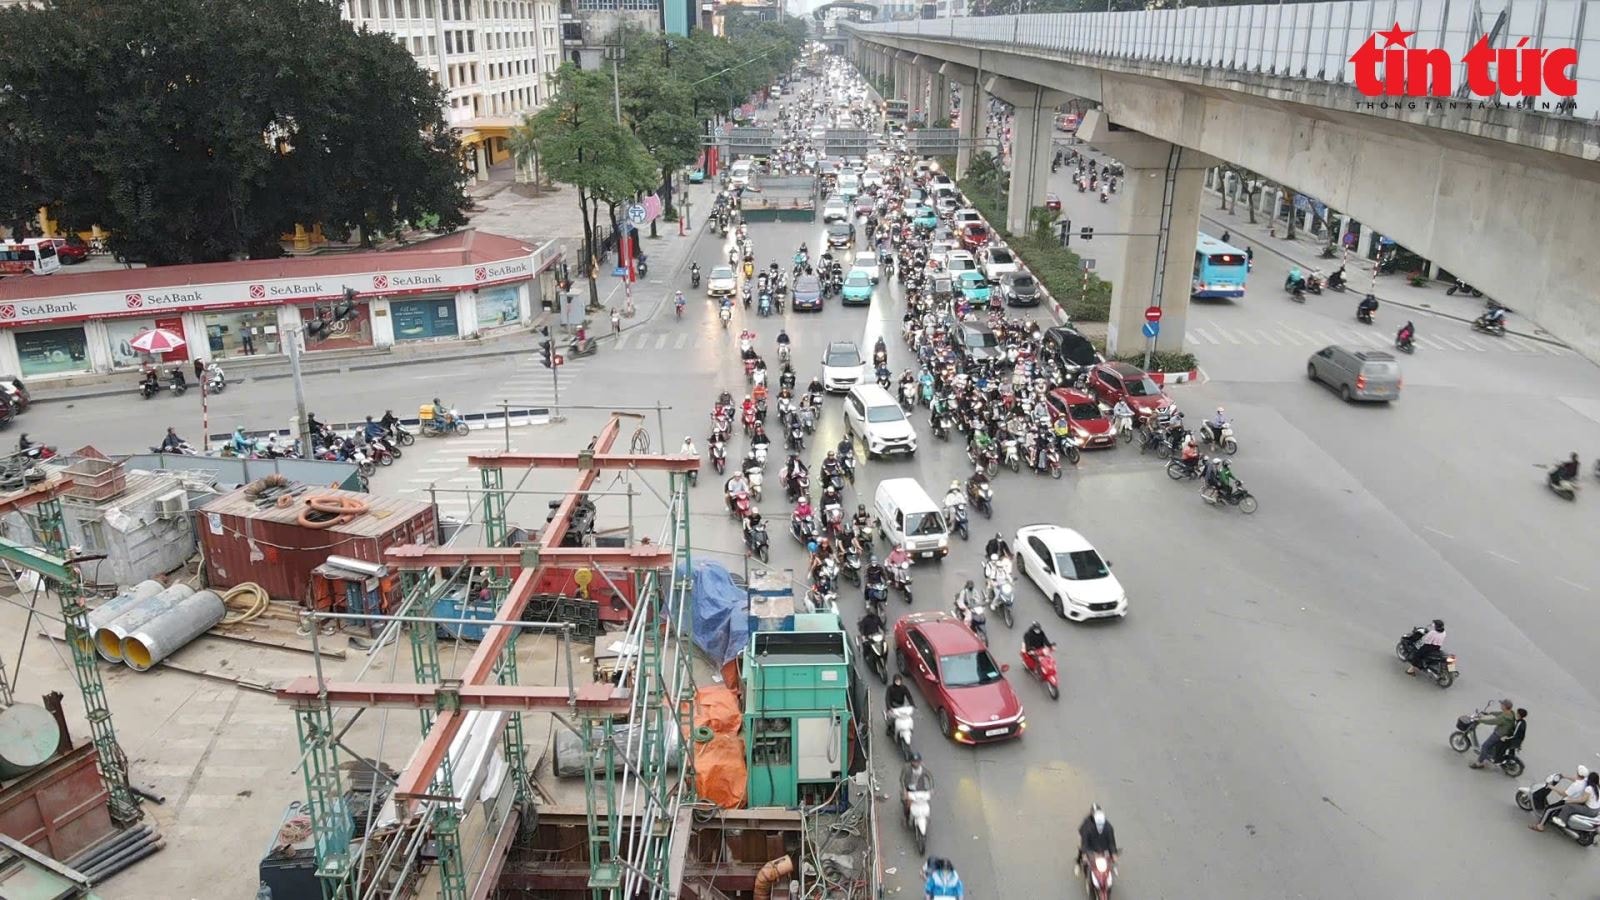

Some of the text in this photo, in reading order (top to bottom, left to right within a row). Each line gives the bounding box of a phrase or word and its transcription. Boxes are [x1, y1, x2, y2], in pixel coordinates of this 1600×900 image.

[488, 263, 527, 277] SeABank
[392, 274, 441, 286] SeABank
[270, 282, 323, 295] SeABank
[147, 291, 202, 305] SeABank
[21, 302, 77, 315] SeABank
